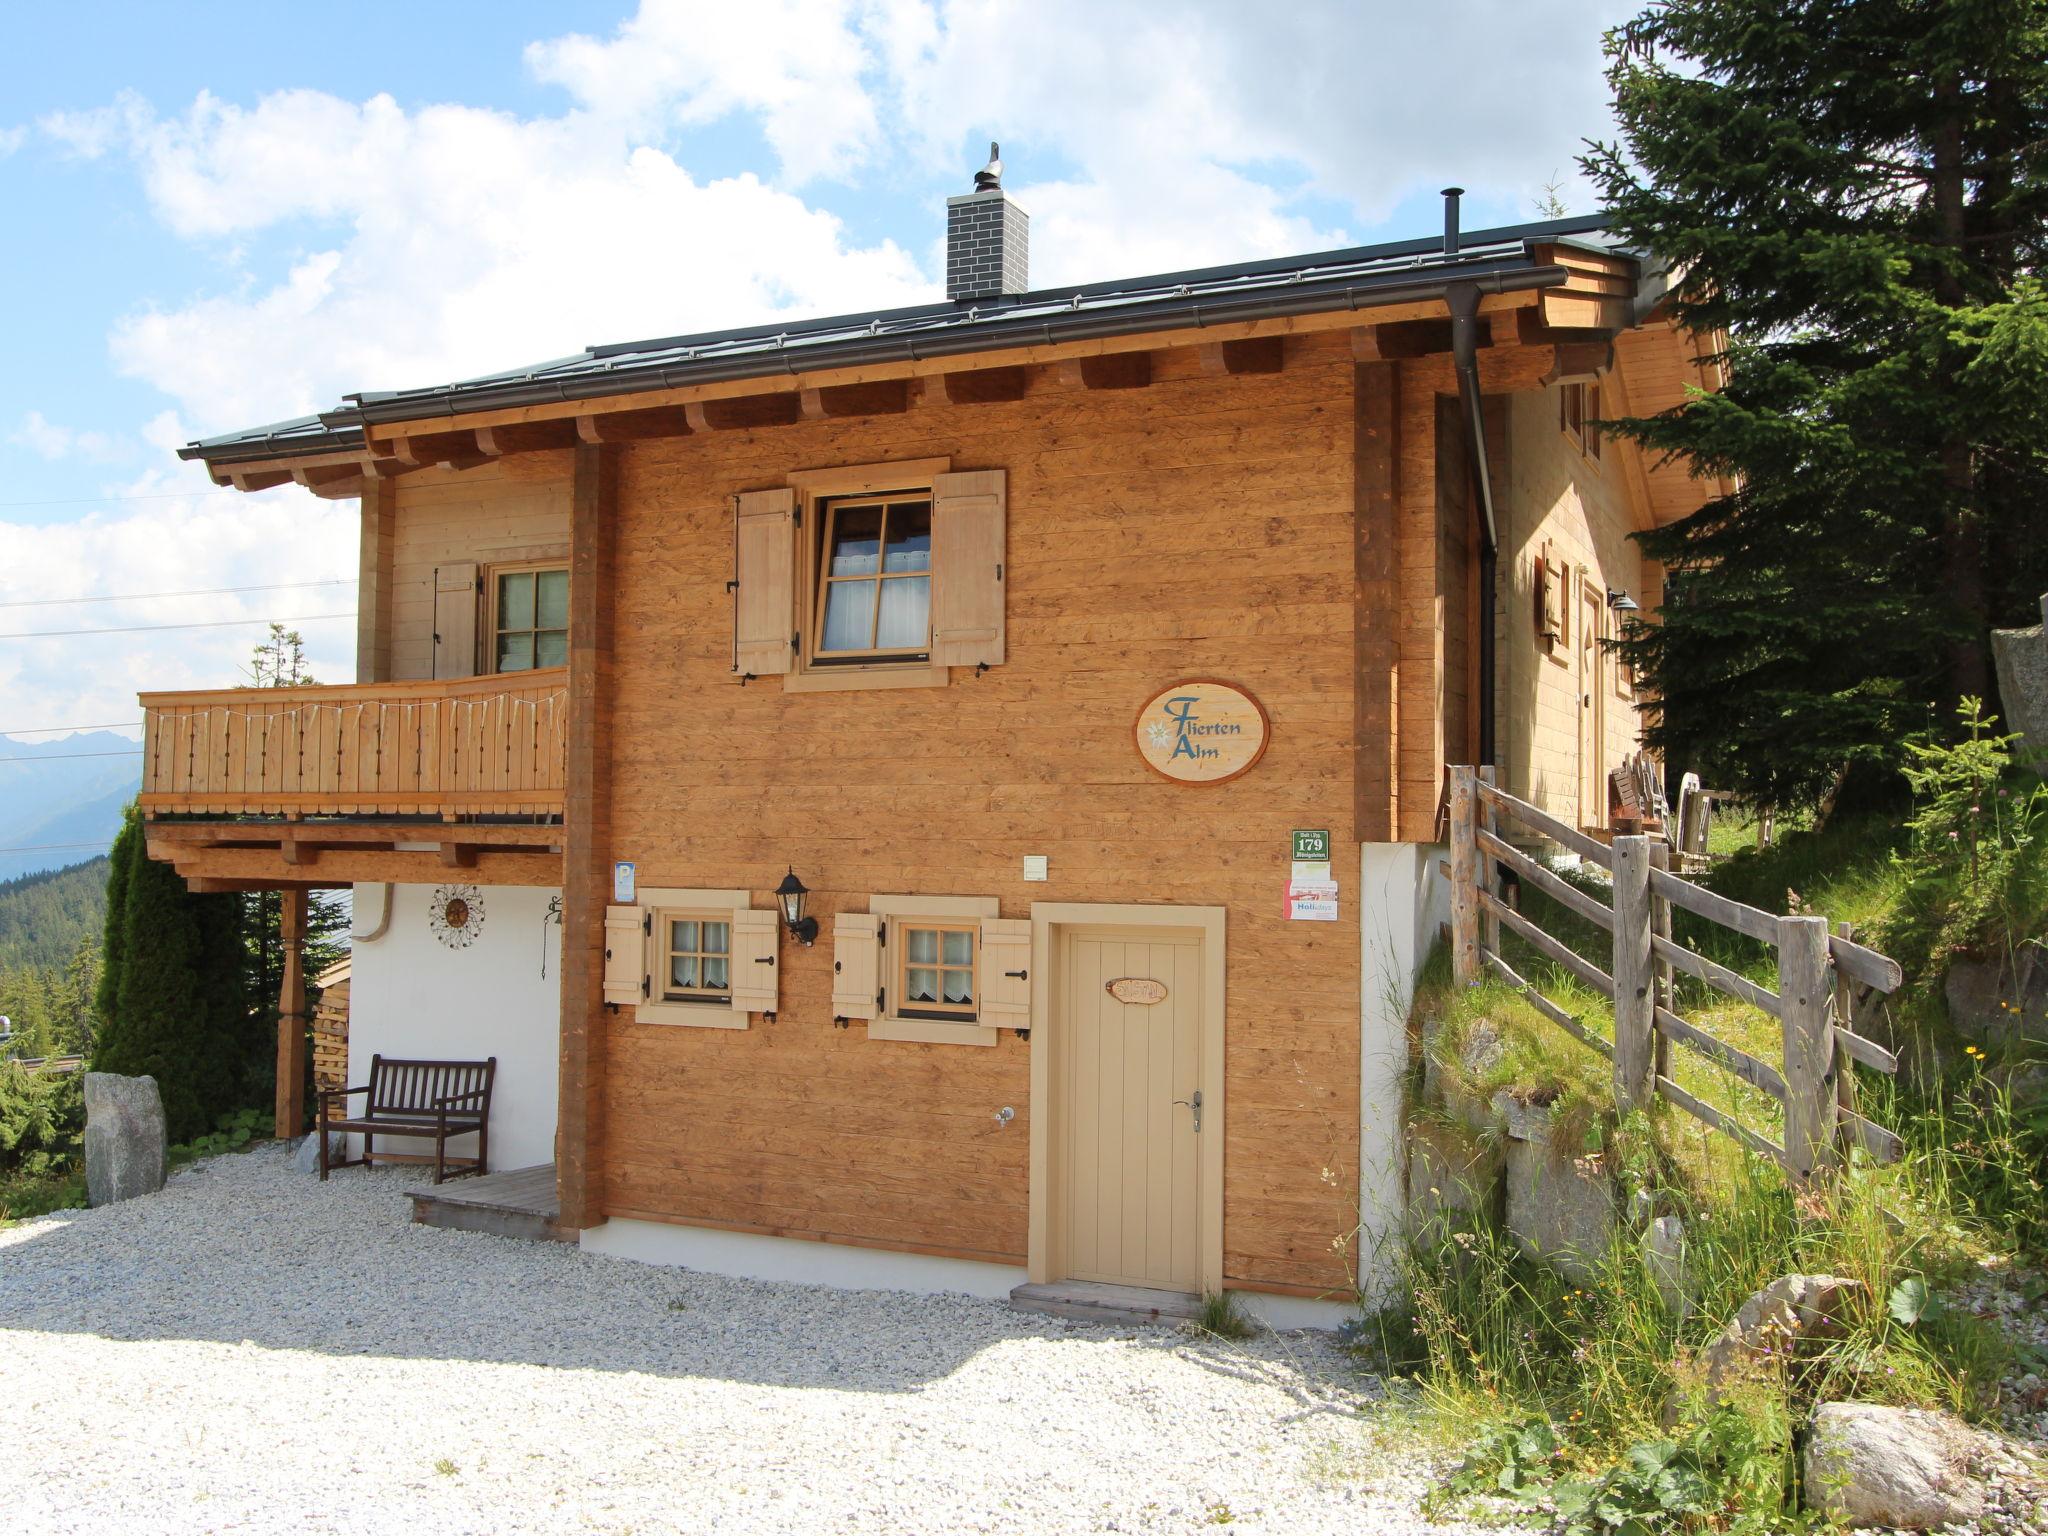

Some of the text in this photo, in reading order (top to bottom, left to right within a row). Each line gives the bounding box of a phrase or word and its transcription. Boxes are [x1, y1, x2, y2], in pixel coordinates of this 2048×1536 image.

[1164, 697, 1241, 737] Flierten
[1171, 734, 1219, 760] Alm
[1298, 838, 1323, 851] 179
